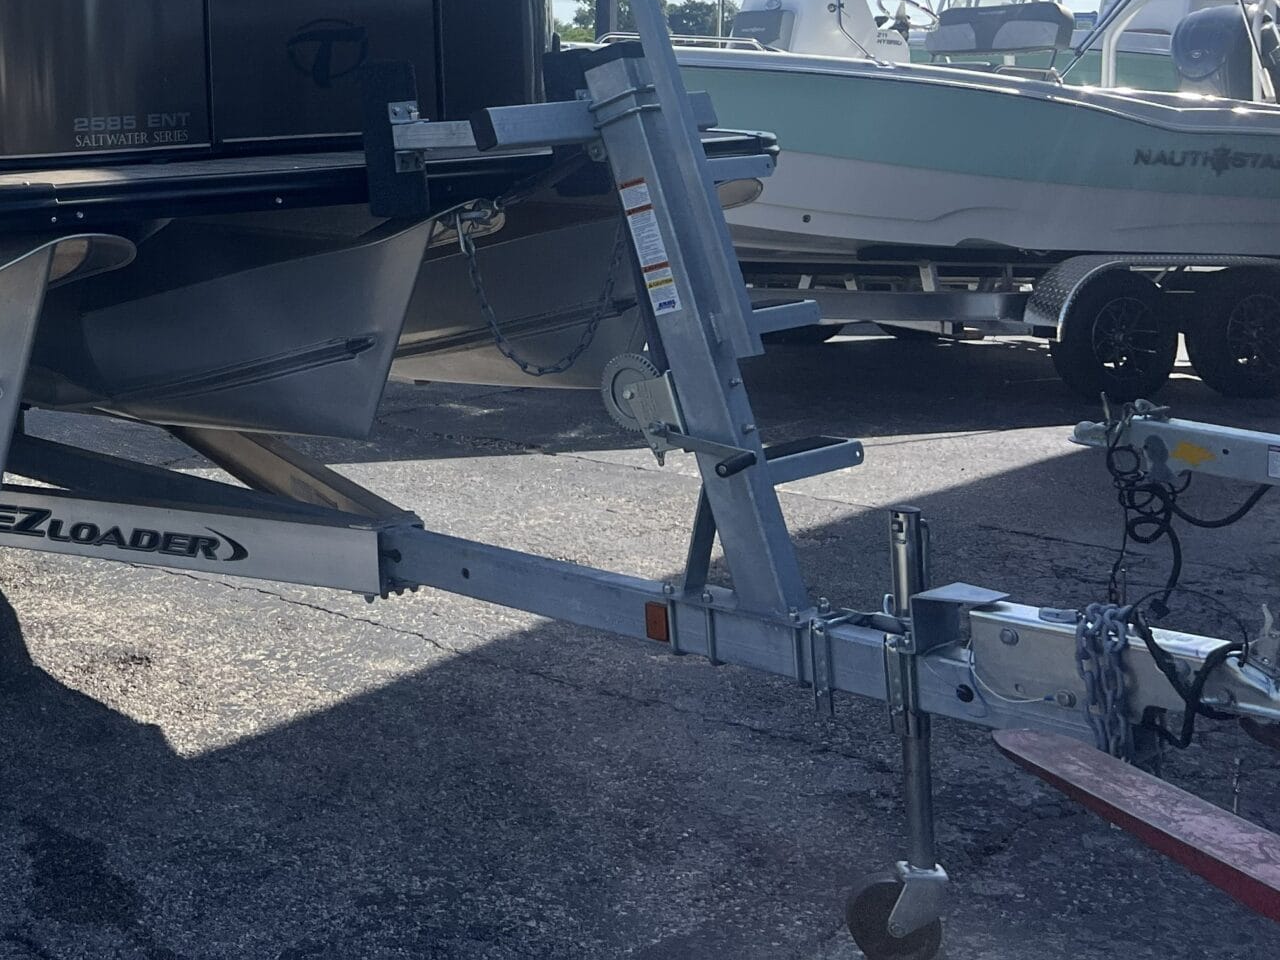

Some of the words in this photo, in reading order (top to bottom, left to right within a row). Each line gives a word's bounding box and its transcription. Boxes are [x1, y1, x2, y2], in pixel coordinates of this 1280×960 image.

[73, 114, 137, 132] 2585
[147, 112, 191, 128] ENT
[75, 131, 150, 148] SALTWATER
[153, 129, 189, 144] SERIES
